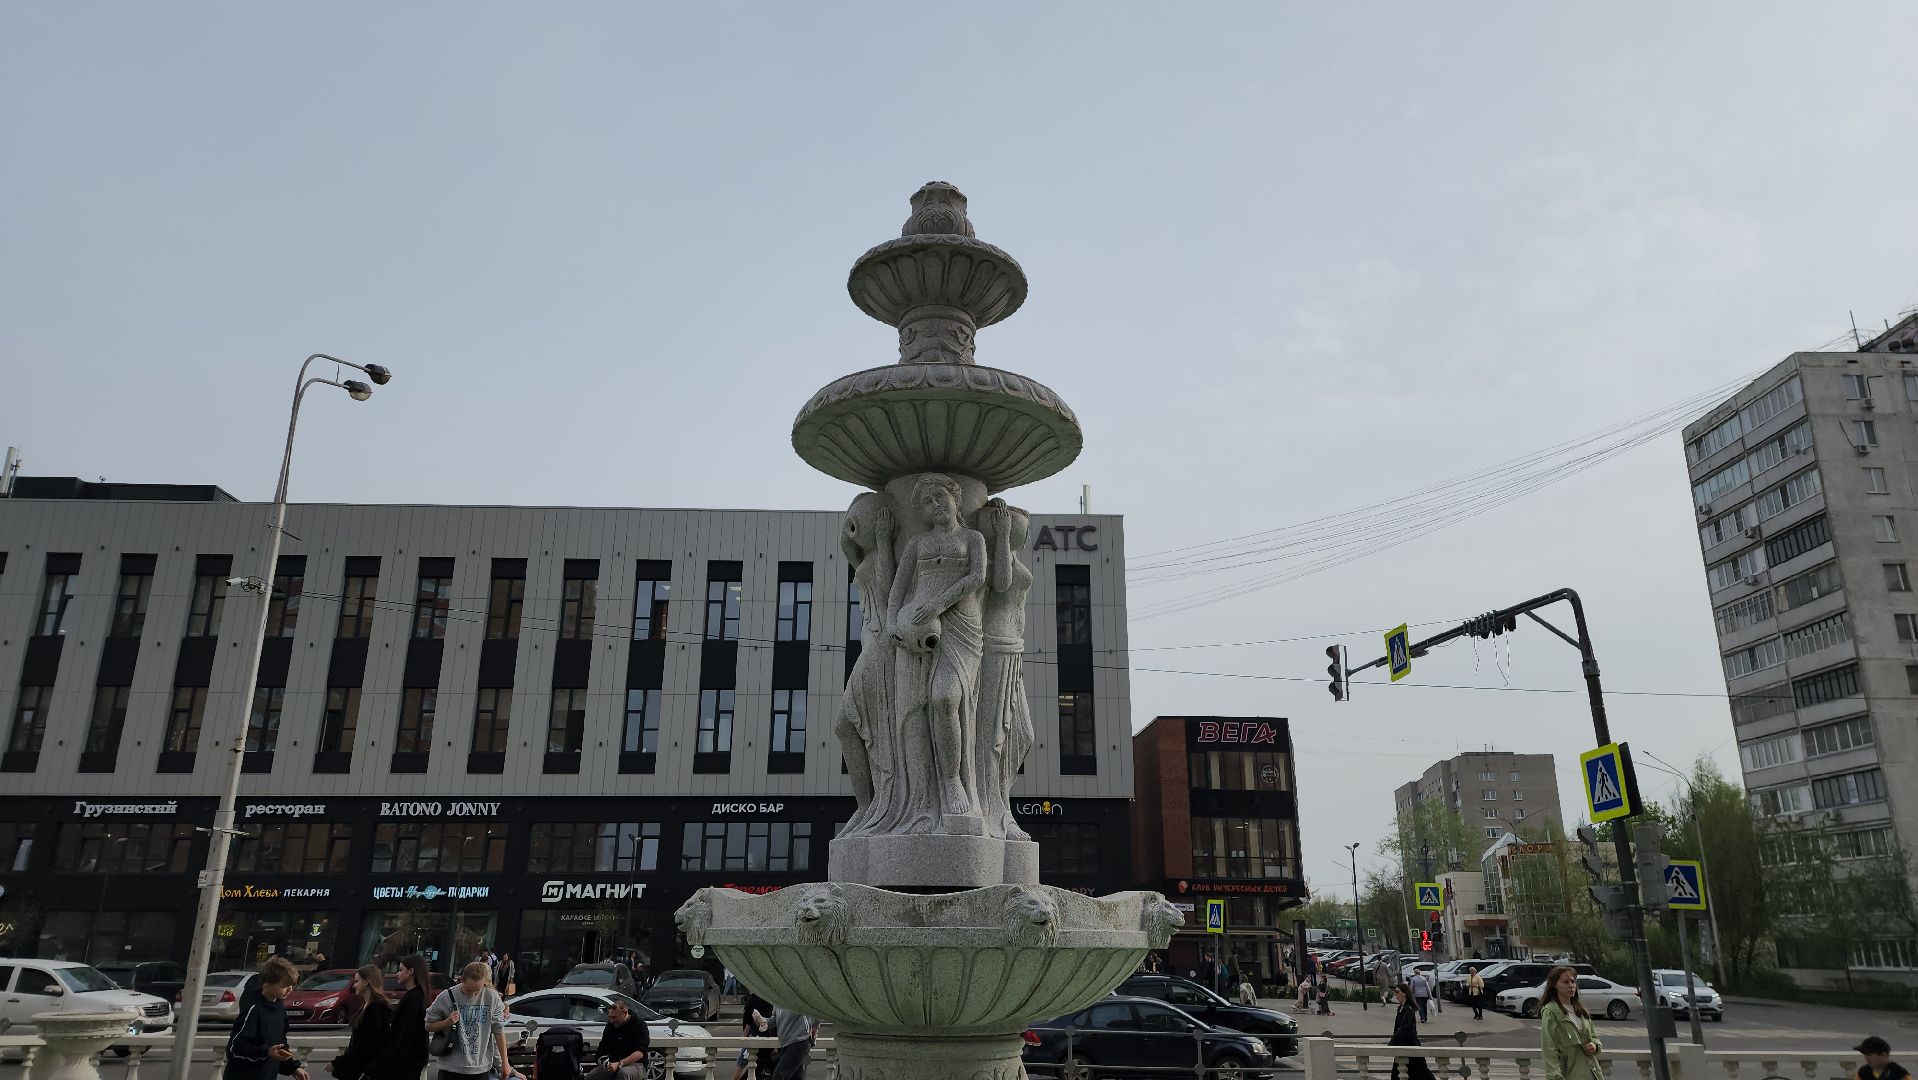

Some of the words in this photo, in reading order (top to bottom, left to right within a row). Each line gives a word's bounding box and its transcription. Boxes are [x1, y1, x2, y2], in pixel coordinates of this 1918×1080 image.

[1033, 525, 1098, 551] АТС
[1198, 722, 1276, 744] ВЕГА
[73, 800, 178, 818] Грузинский
[244, 804, 326, 818] ресторан
[379, 802, 443, 816] BATONO
[447, 802, 502, 816] JONNY
[711, 803, 757, 815] ДИСКО
[759, 803, 784, 813] БАР
[283, 888, 330, 898] ПЕКАРНЯ
[373, 886, 404, 899] ЦВЕТЫ
[565, 883, 647, 899] МАГНИТ
